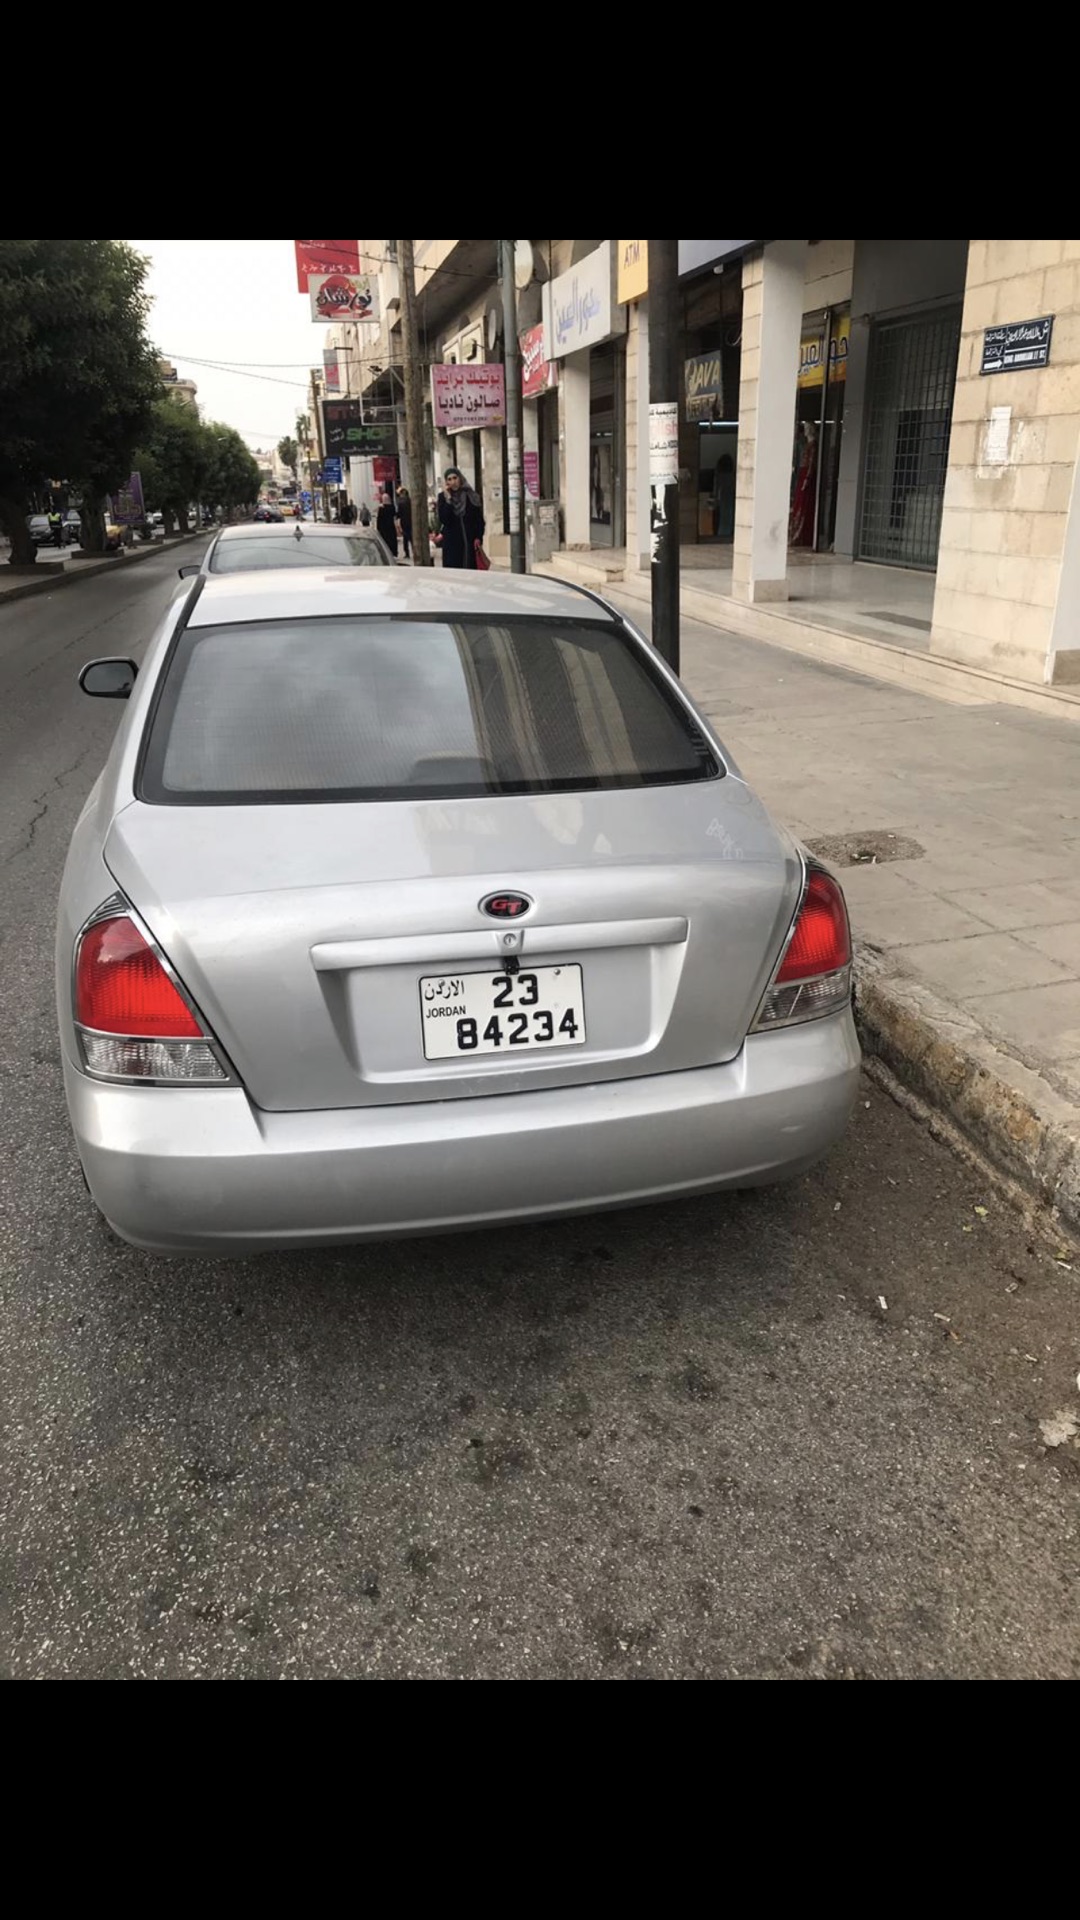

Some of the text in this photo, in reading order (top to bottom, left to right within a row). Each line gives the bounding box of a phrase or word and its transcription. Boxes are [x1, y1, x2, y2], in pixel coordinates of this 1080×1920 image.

[624, 240, 640, 270] ATM
[438, 394, 500, 414] صالون ناديا
[346, 427, 393, 441] SHOP
[491, 898, 522, 915] GT
[492, 974, 539, 1009] 23
[426, 1005, 466, 1018] JORDAN
[456, 1008, 578, 1050] 84234
